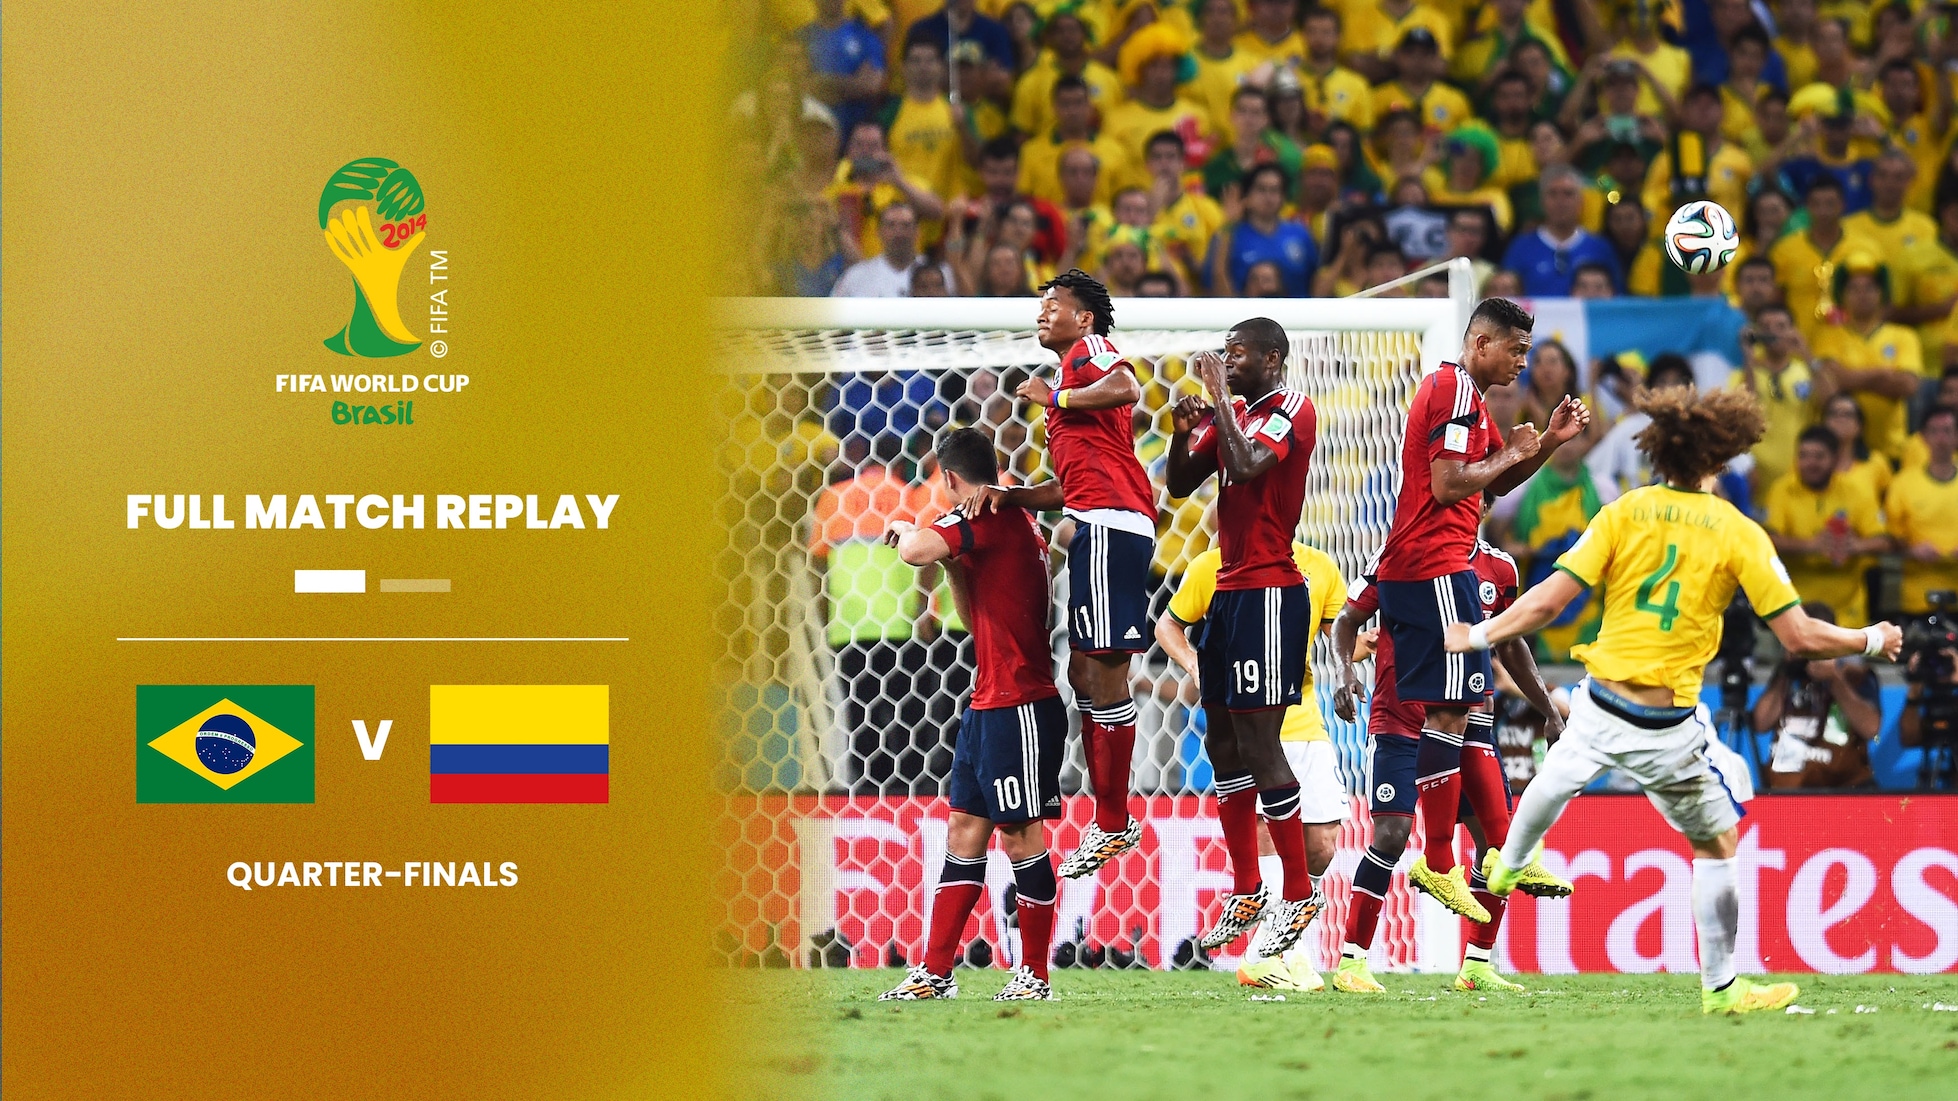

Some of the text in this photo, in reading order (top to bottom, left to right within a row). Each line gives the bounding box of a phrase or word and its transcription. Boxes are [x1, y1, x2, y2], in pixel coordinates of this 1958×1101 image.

[1633, 504, 1680, 523] DAVID
[1634, 544, 1680, 632] 4
[1233, 659, 1259, 694] 19
[993, 775, 1022, 812] 10
